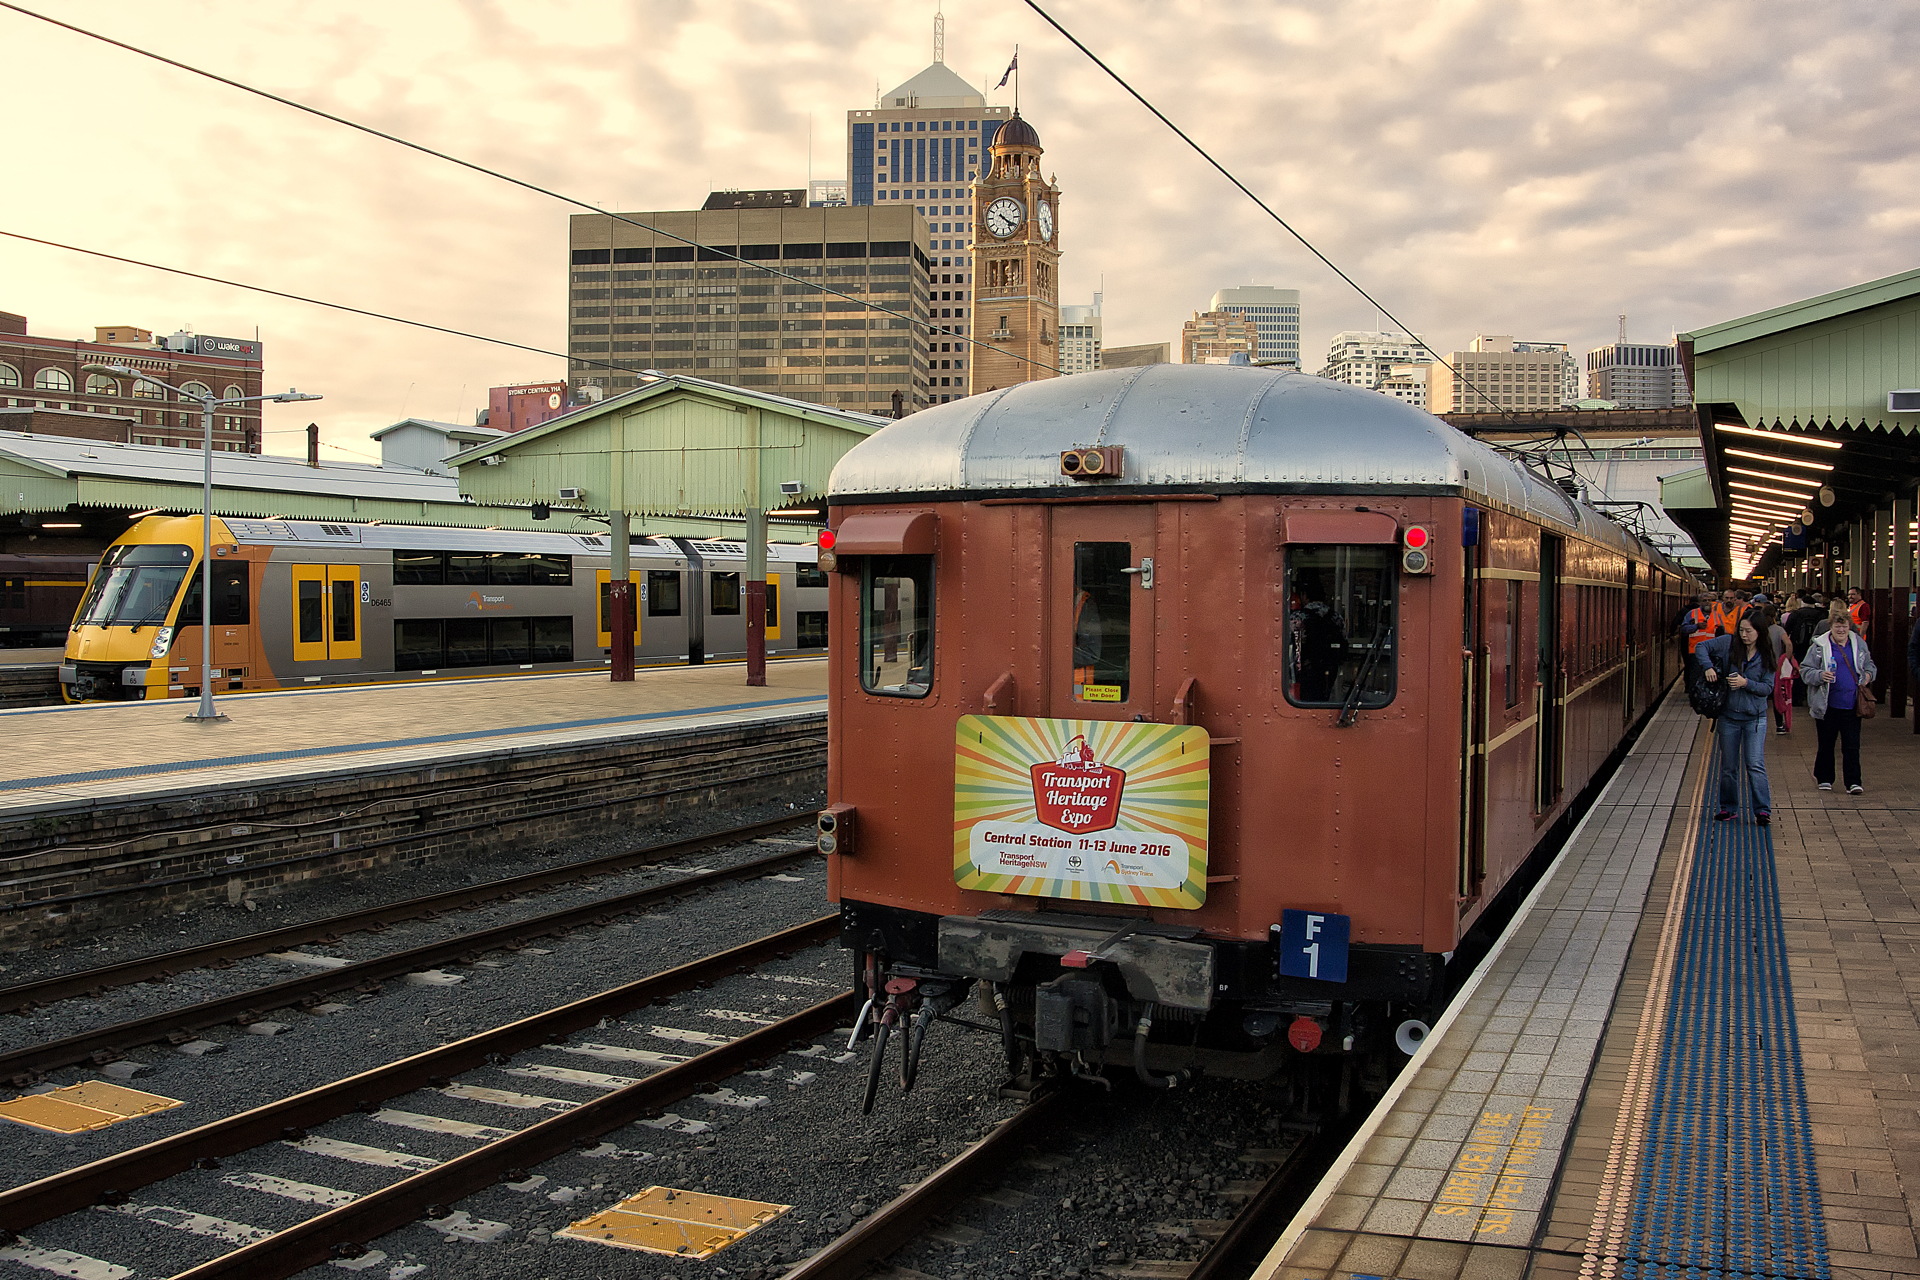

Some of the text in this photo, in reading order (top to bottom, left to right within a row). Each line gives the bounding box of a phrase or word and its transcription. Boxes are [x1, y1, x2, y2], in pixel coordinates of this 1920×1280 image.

[217, 342, 254, 354] wake up!
[508, 388, 528, 396] SYDNEY
[528, 386, 550, 394] CENTRAL
[1832, 546, 1839, 555] 8
[371, 599, 392, 607] D6465
[1041, 772, 1111, 792] Transport
[1046, 790, 1108, 811] Heritage
[1060, 809, 1093, 828] Expo
[984, 831, 1171, 857] Central Station 11-13 June 2016
[999, 851, 1034, 861] Transport
[999, 857, 1048, 869] HeritageNSW
[1120, 869, 1139, 877] Sydney
[1306, 915, 1325, 940] F
[1303, 943, 1319, 977] 1
[1434, 1112, 1513, 1216] SURFACE MAY BE
[1472, 1105, 1555, 1234] SLIPPERY WHEN WET
